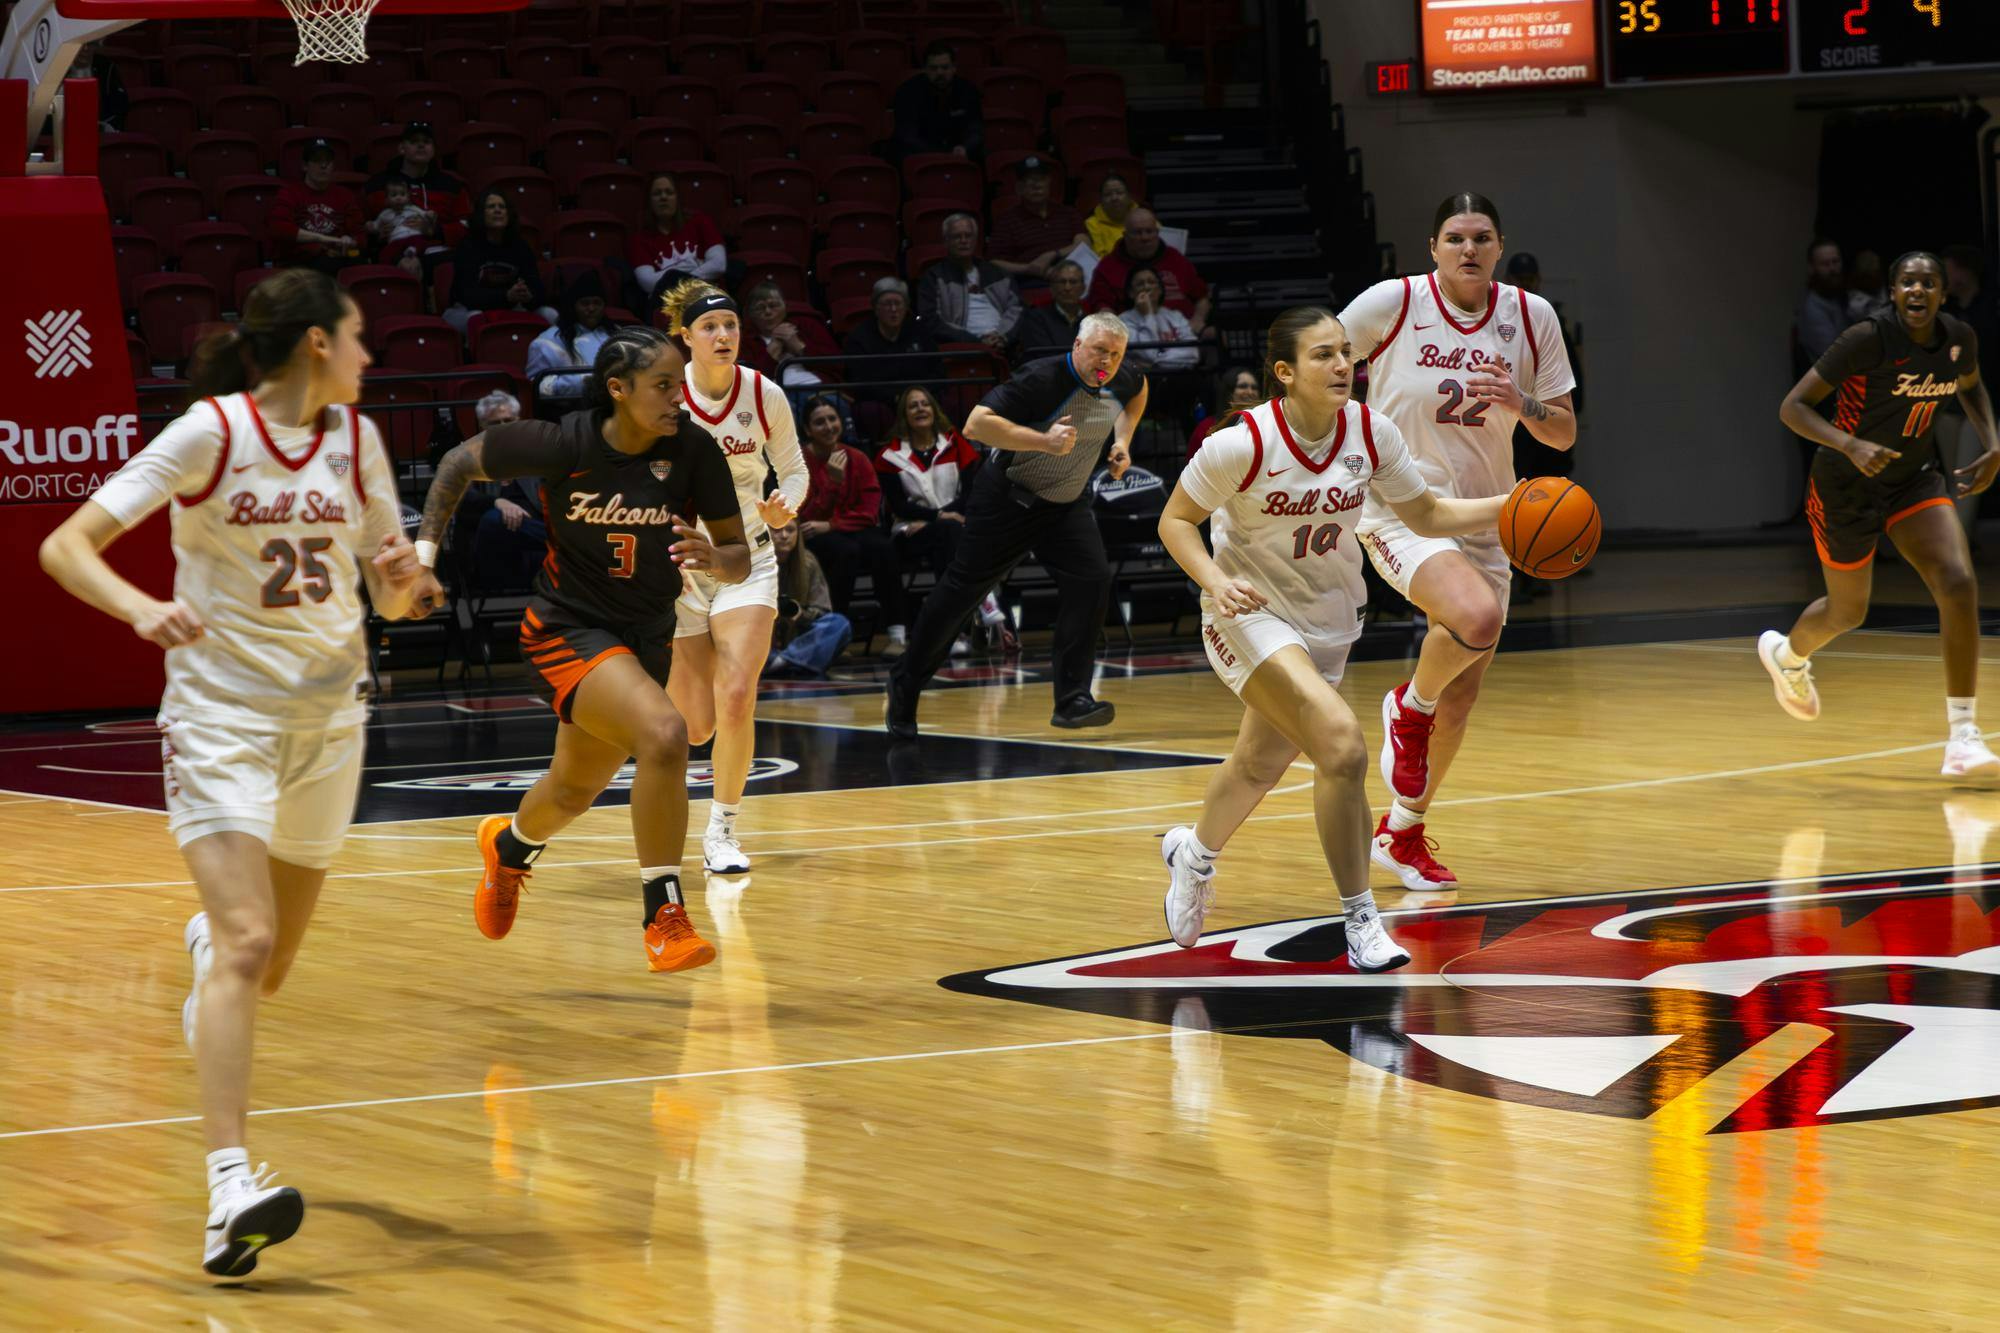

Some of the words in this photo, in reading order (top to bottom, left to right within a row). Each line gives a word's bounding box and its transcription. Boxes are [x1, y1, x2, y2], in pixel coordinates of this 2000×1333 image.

[1445, 28, 1485, 41] TEAM
[1488, 26, 1523, 38] BALL
[1528, 23, 1573, 36] STATE
[1453, 16, 1492, 27] PROUD
[1494, 12, 1540, 24] PARTNER
[1543, 11, 1561, 21] OF
[1619, 0, 1661, 33] 35
[1452, 42, 1476, 53] FOR
[1477, 41, 1507, 52] OVER
[1509, 40, 1524, 50] 30
[1820, 44, 1881, 68] SCORE
[1377, 64, 1409, 91] EXIT
[1432, 64, 1587, 88] StoopsAuto.com
[1416, 344, 1466, 367] Ball
[1435, 378, 1492, 427] 22
[1902, 401, 1939, 439] 11
[0, 414, 137, 465] Ruoff
[225, 489, 296, 526] Ball
[565, 491, 671, 525] Falcons
[1261, 487, 1321, 516] Ball
[606, 532, 637, 578] 3
[1292, 523, 1343, 559] 10
[259, 537, 333, 608] 25
